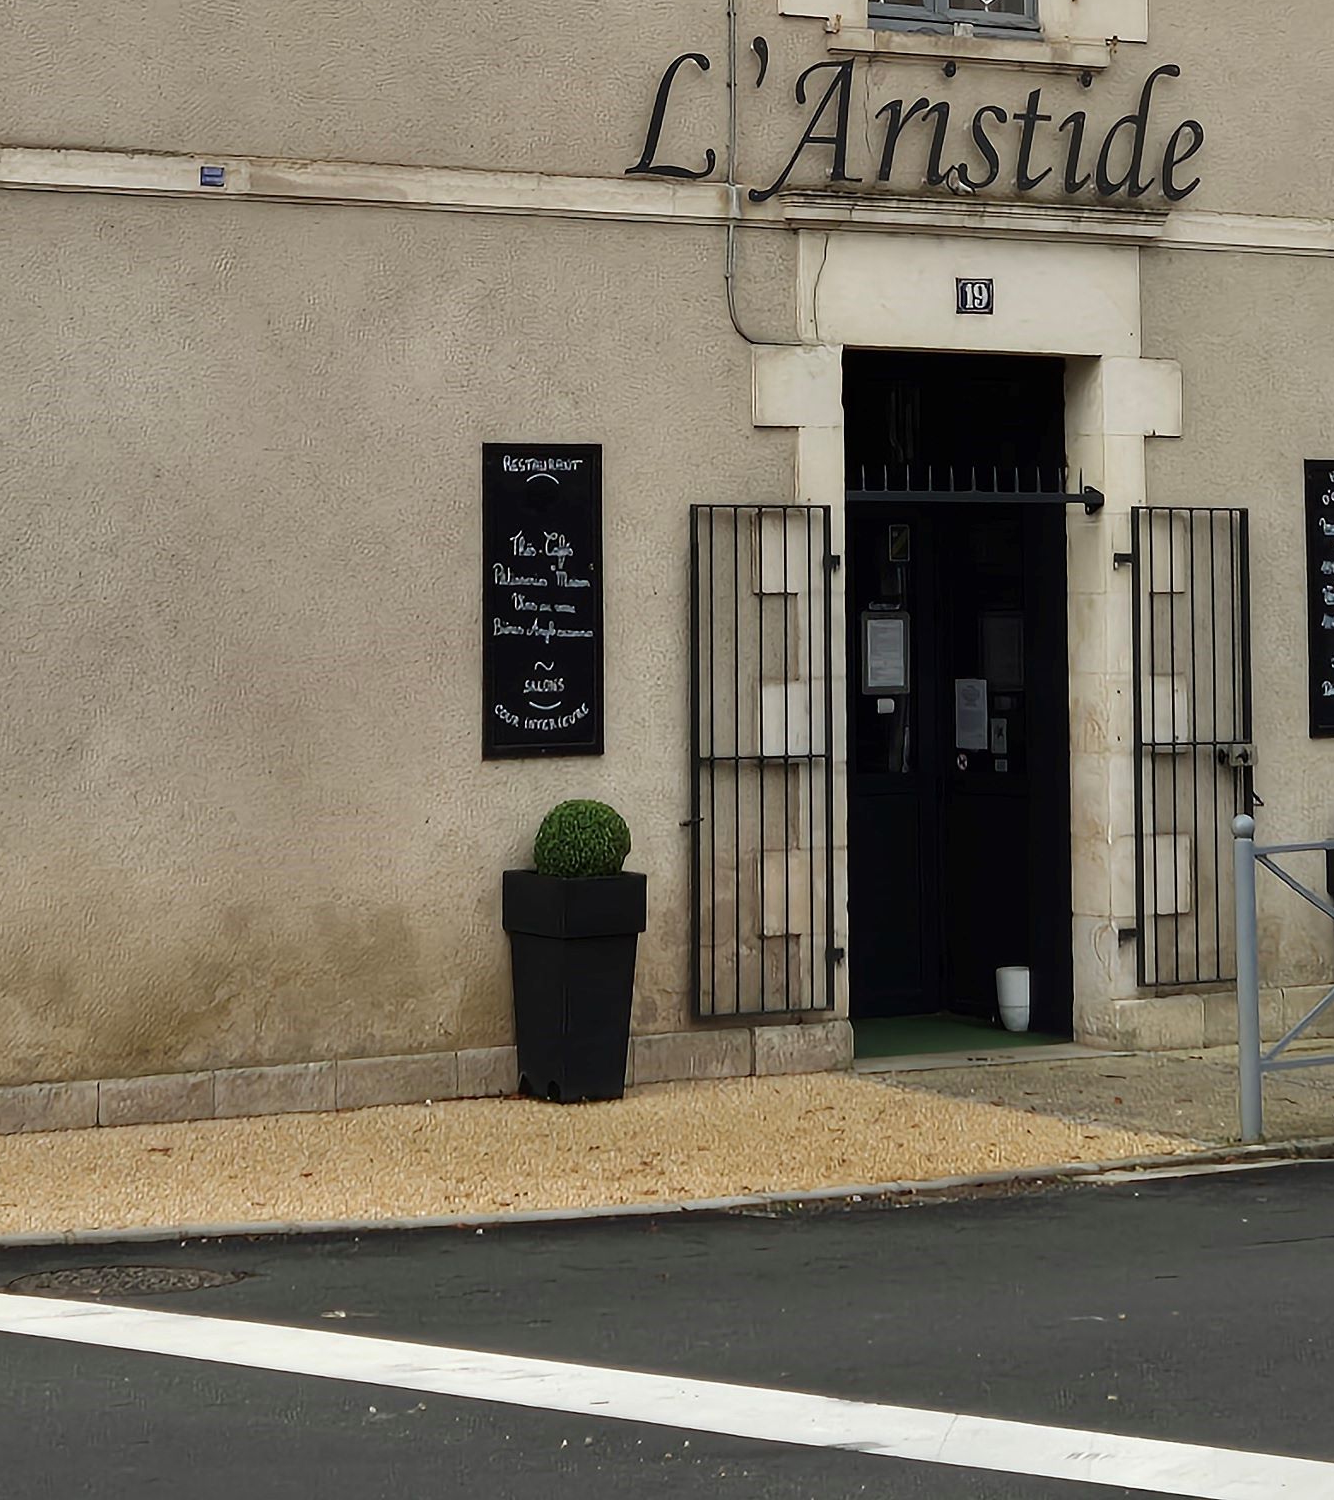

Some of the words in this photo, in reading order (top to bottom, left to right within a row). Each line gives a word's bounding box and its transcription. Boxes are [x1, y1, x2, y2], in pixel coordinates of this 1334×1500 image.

[624, 35, 1206, 202] L'Aristide
[965, 283, 989, 309] 19
[503, 455, 584, 472] RESTAURANT
